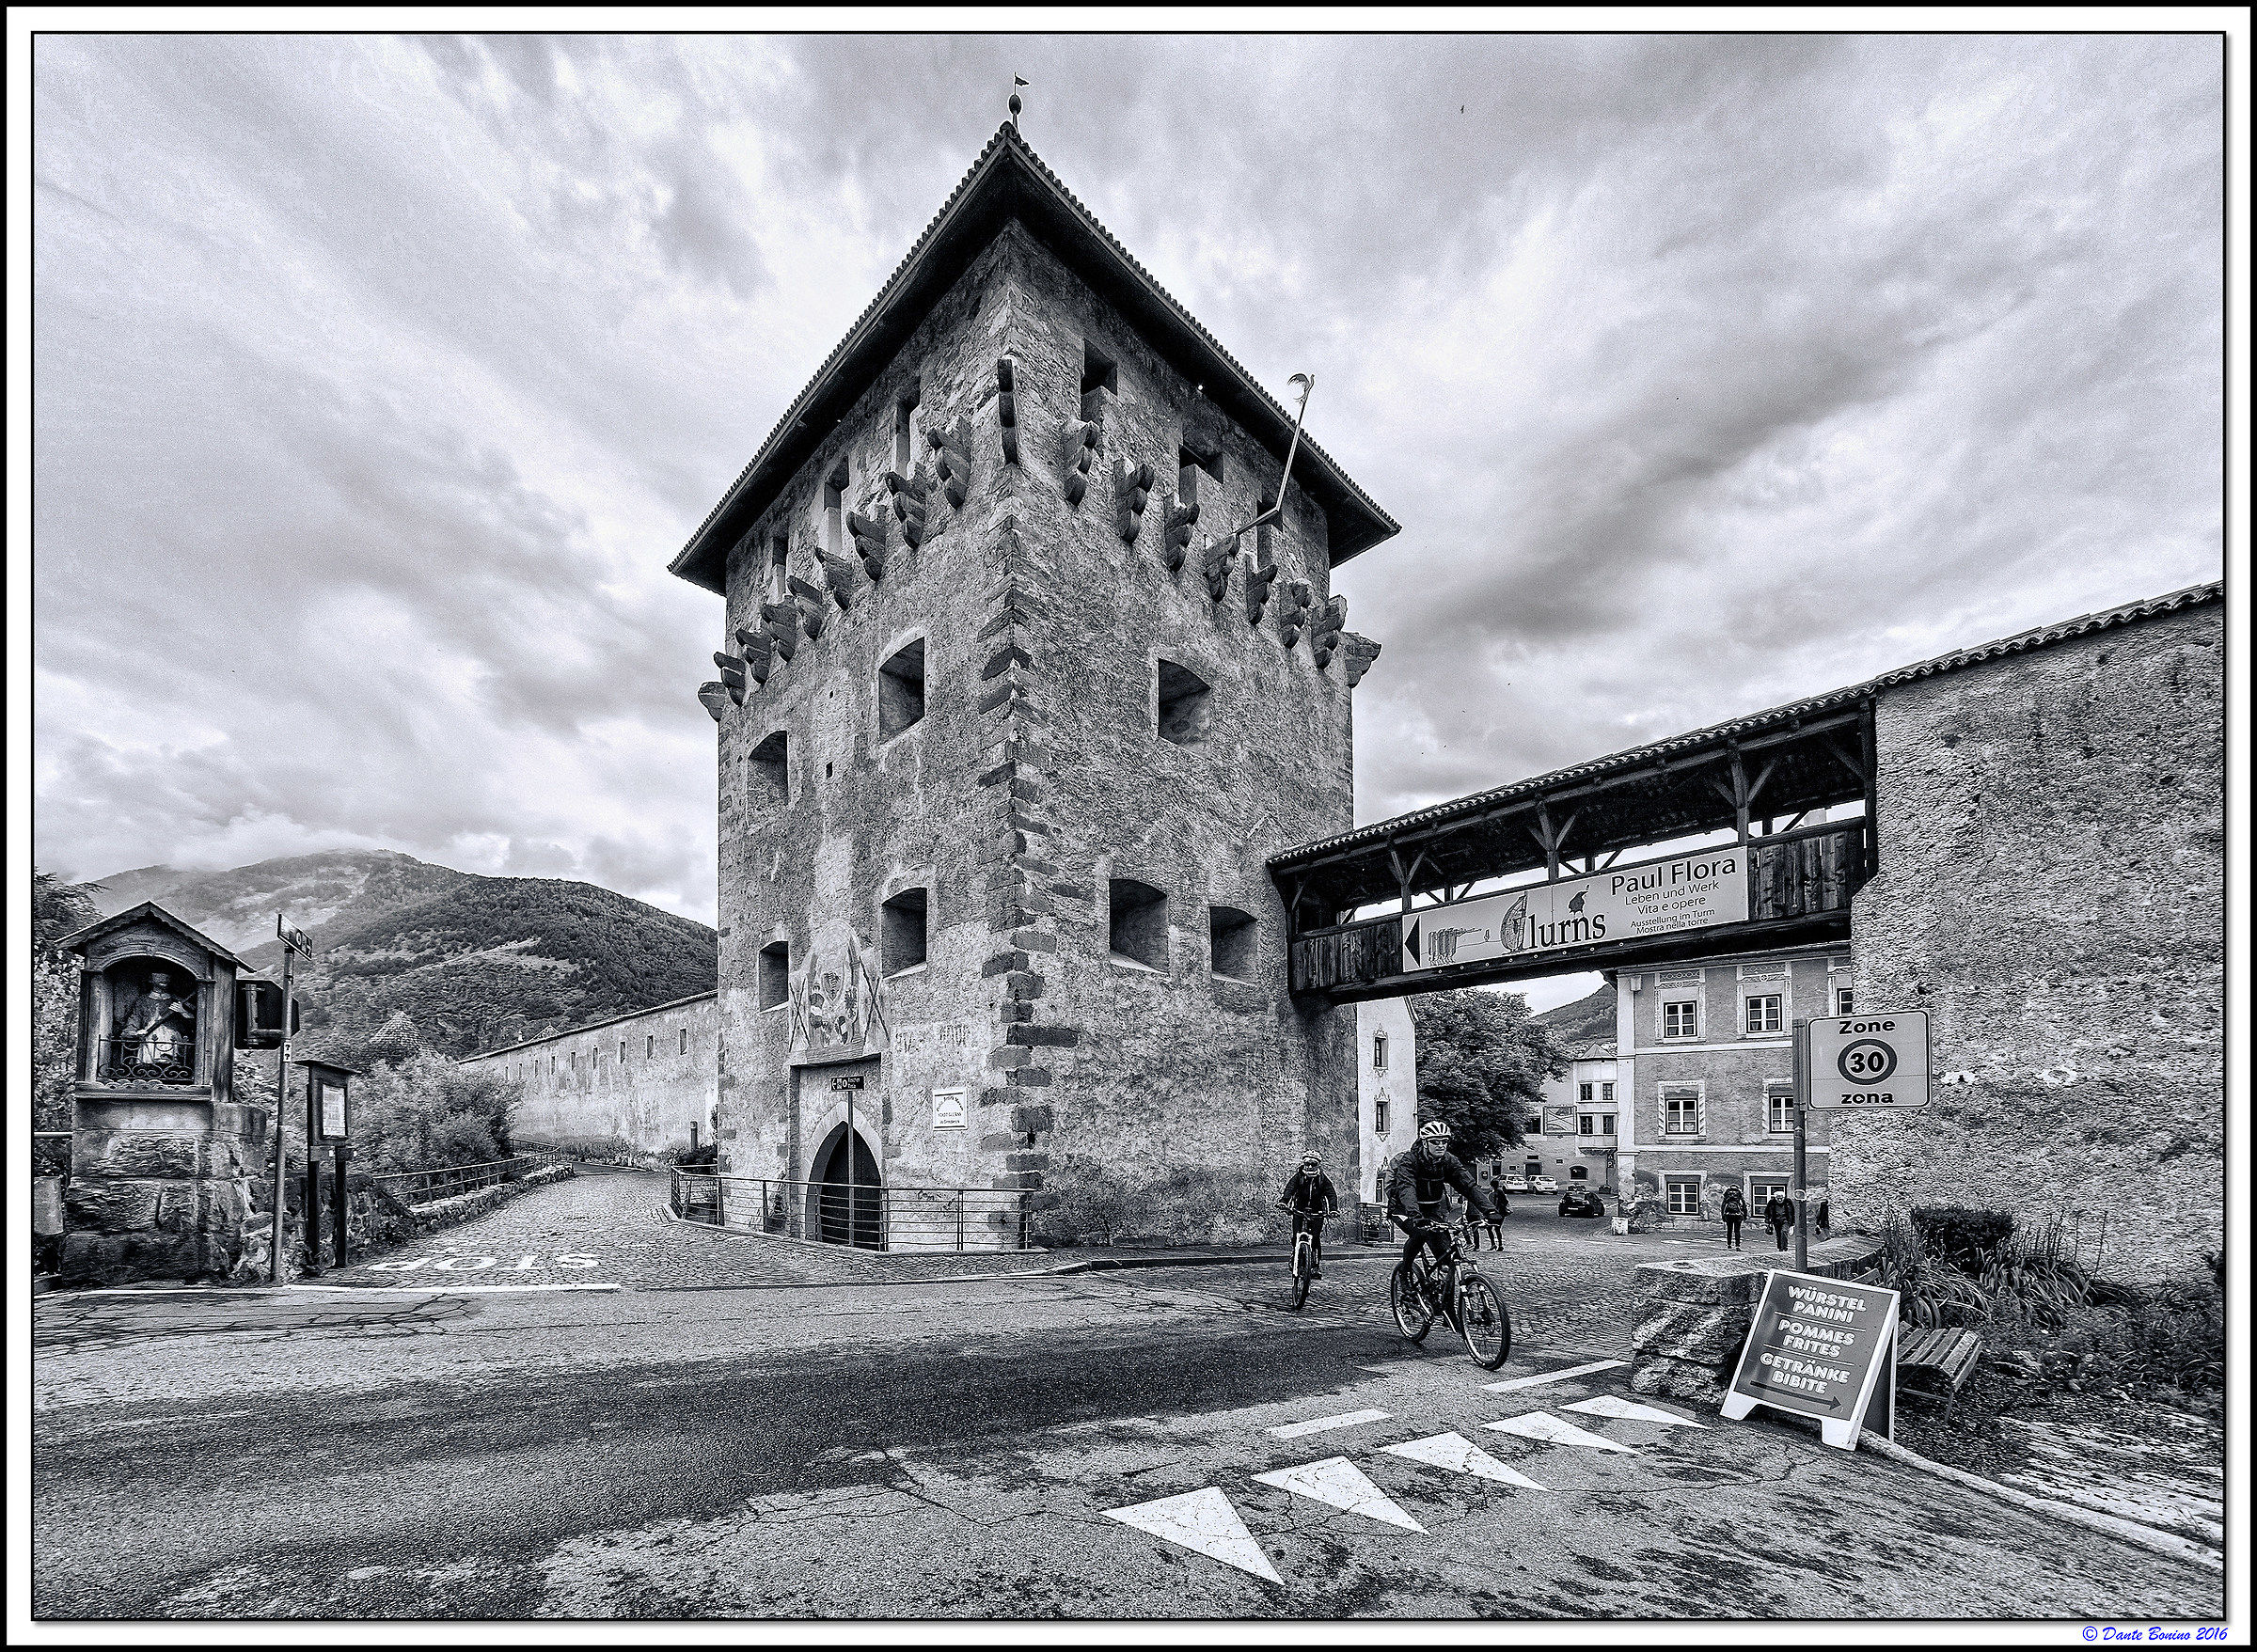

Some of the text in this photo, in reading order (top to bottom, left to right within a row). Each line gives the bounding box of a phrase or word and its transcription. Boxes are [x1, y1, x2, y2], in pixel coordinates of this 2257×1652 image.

[1611, 857, 1736, 895] Paul Flora
[1625, 879, 1720, 905] Leben und Werk
[1637, 896, 1706, 915] Vita e opere
[1630, 915, 1678, 928] Ausstellung
[1693, 908, 1715, 919] Turm
[1636, 918, 1709, 935] Mostra nella torre
[1839, 1020, 1896, 1034] Zone
[1850, 1051, 1885, 1073] 30
[1840, 1092, 1894, 1105] zona
[1787, 1285, 1867, 1312] WÜRSTEL
[1792, 1300, 1855, 1323] PANINI
[1777, 1319, 1855, 1346] POMMES
[1782, 1334, 1841, 1358] FRITES
[1760, 1352, 1851, 1383] GETRÄNKE
[1772, 1370, 1828, 1394] BIBITE
